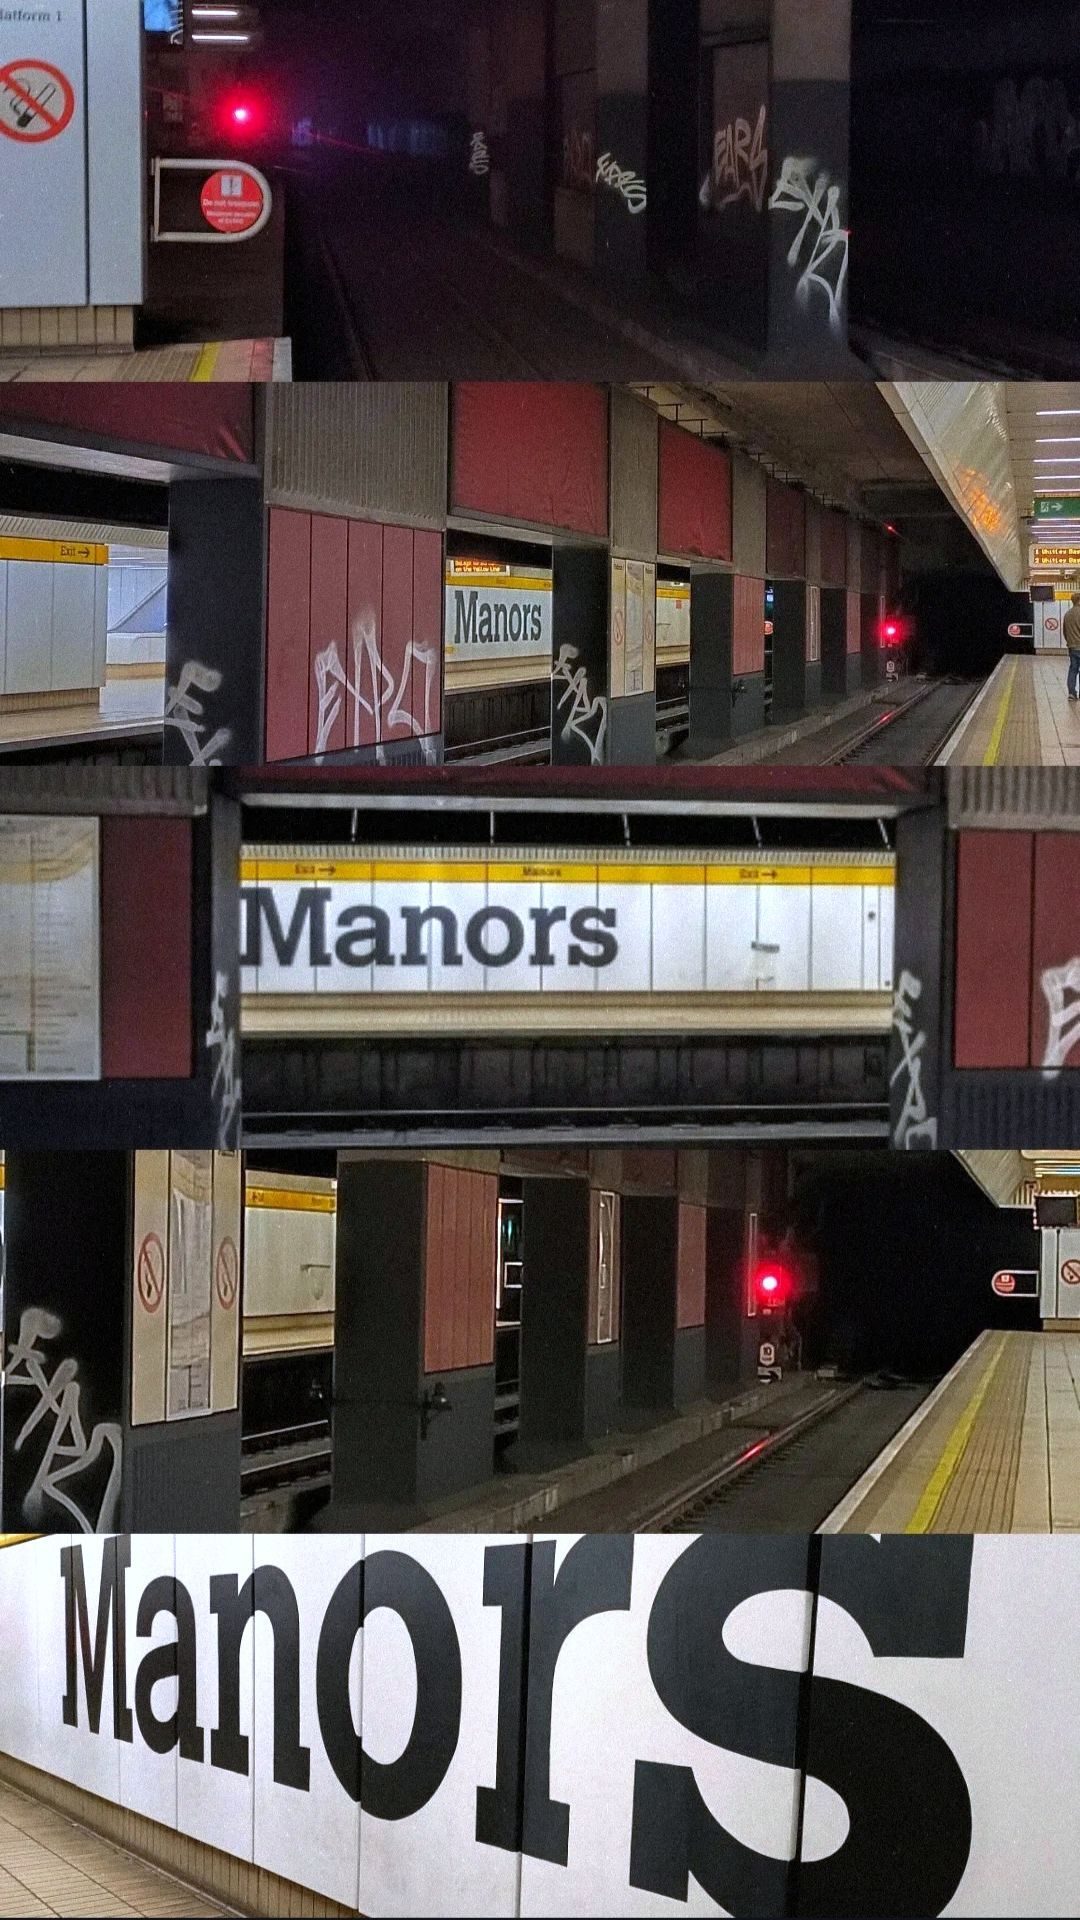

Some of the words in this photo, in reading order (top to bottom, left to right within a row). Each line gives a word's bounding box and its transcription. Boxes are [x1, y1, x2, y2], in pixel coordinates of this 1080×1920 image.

[454, 590, 542, 644] Manors
[240, 886, 619, 968] Manors
[60, 1534, 973, 1918] Manors
